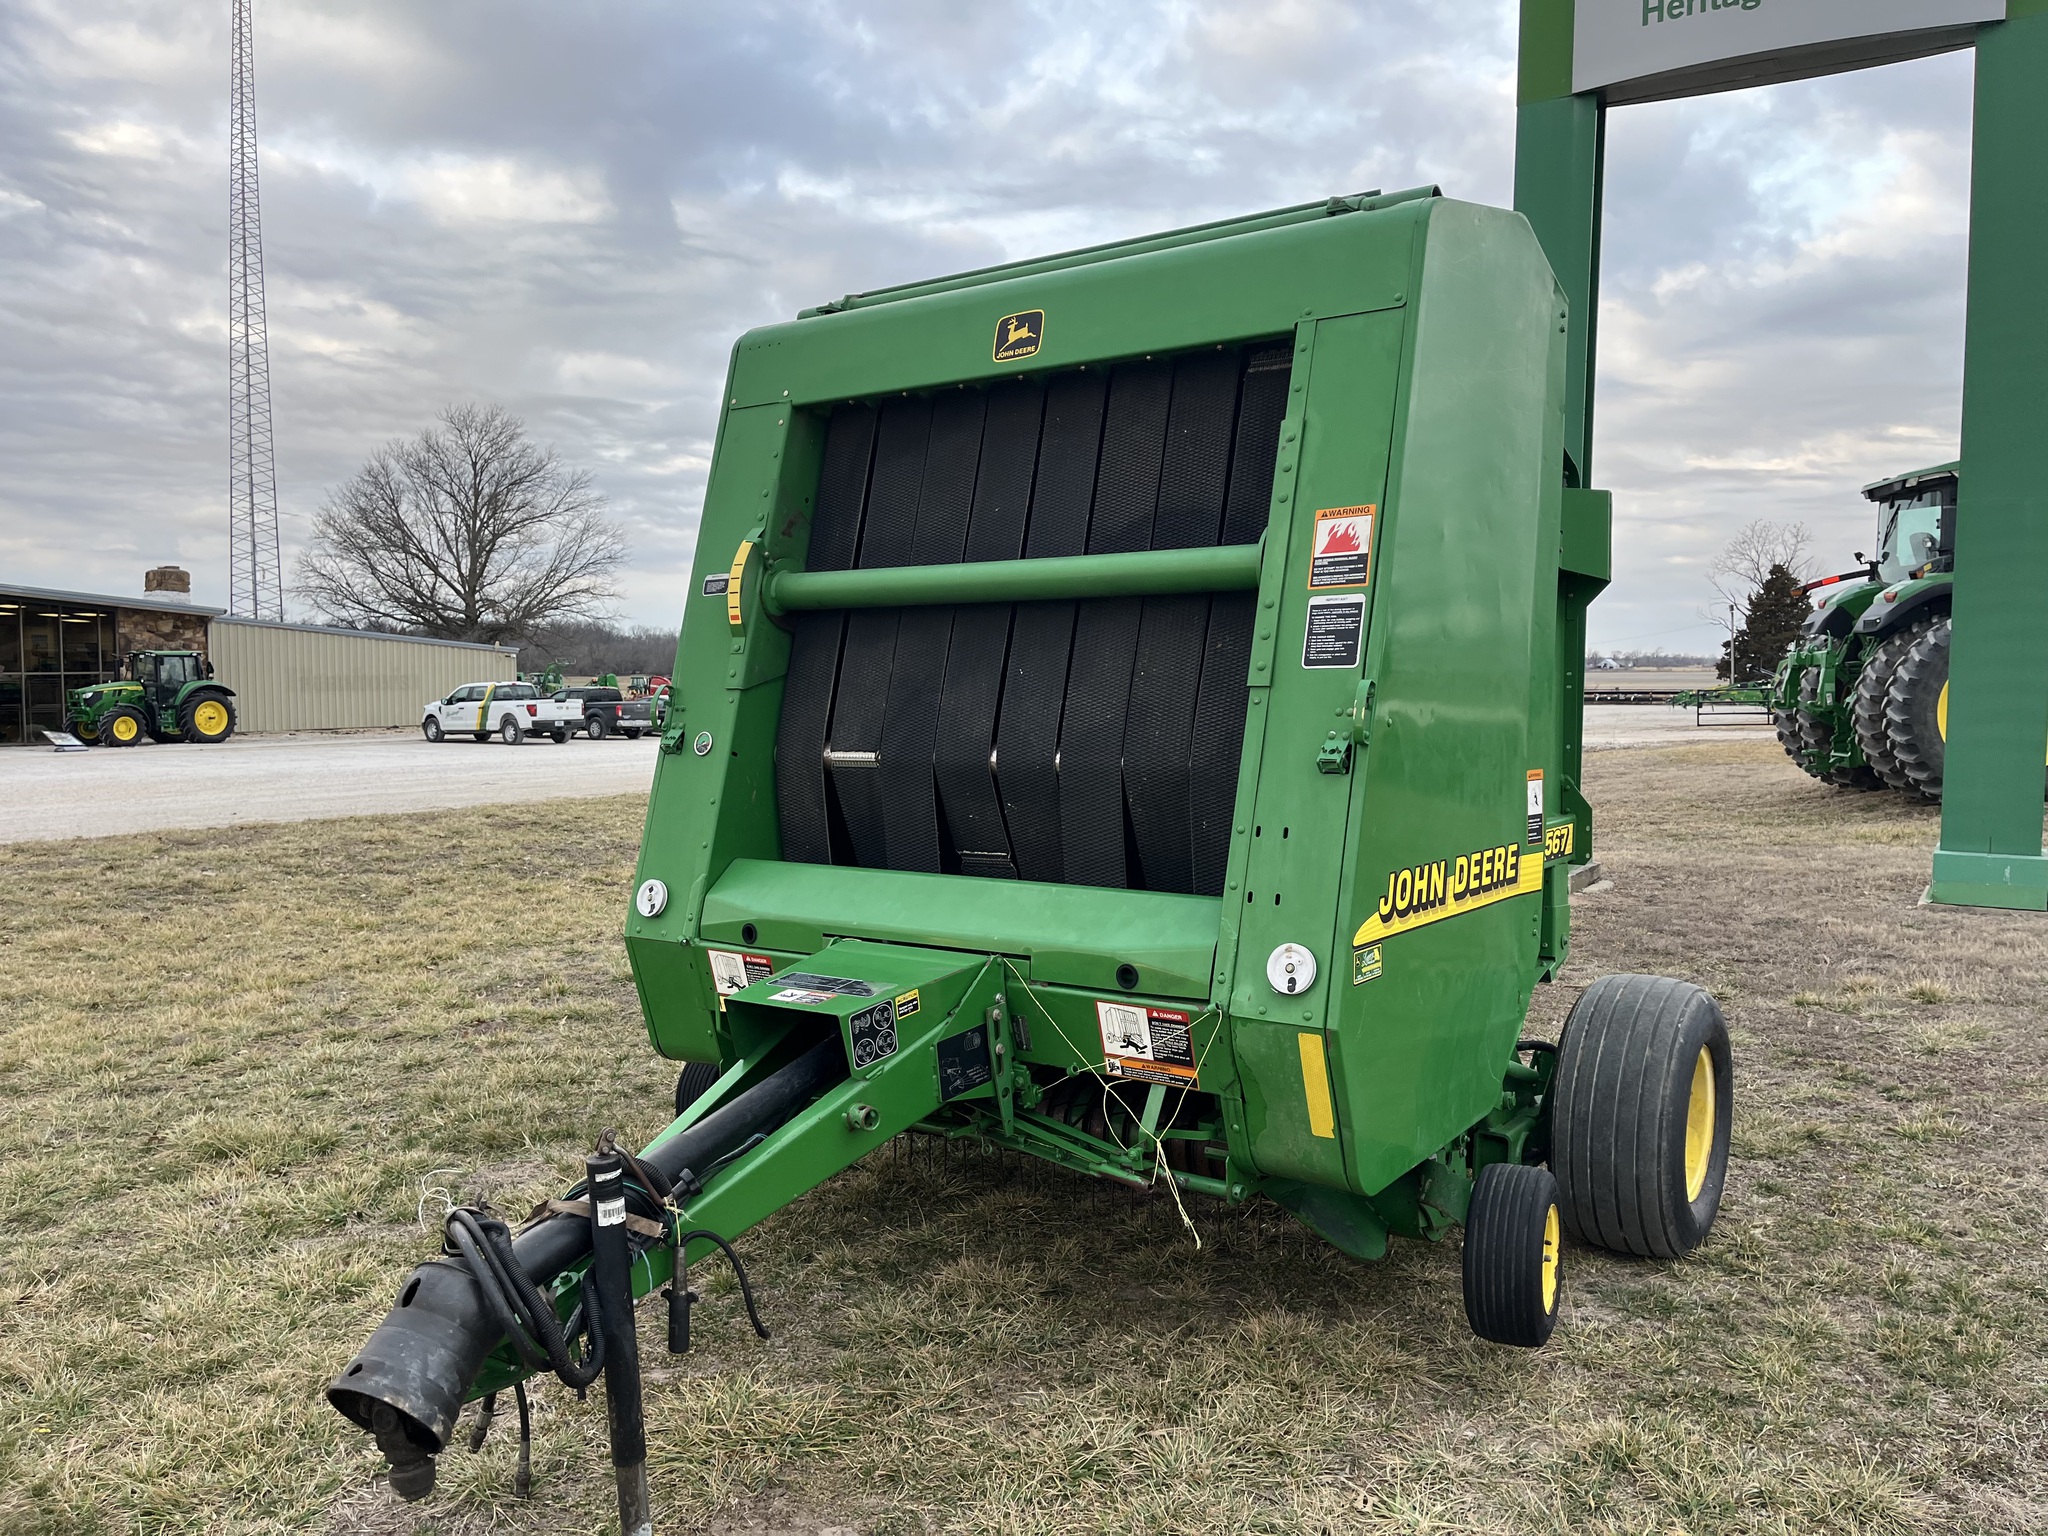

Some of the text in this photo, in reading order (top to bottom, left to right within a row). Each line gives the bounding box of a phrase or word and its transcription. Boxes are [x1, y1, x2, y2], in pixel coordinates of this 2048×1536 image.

[997, 346, 1036, 358] JOHN DEERE
[1329, 506, 1370, 517] WARNING
[1545, 827, 1569, 857] 567
[1378, 842, 1520, 921] JOHN DEERE
[1159, 1012, 1183, 1021] DANGER
[1146, 1064, 1171, 1073] WARNING
